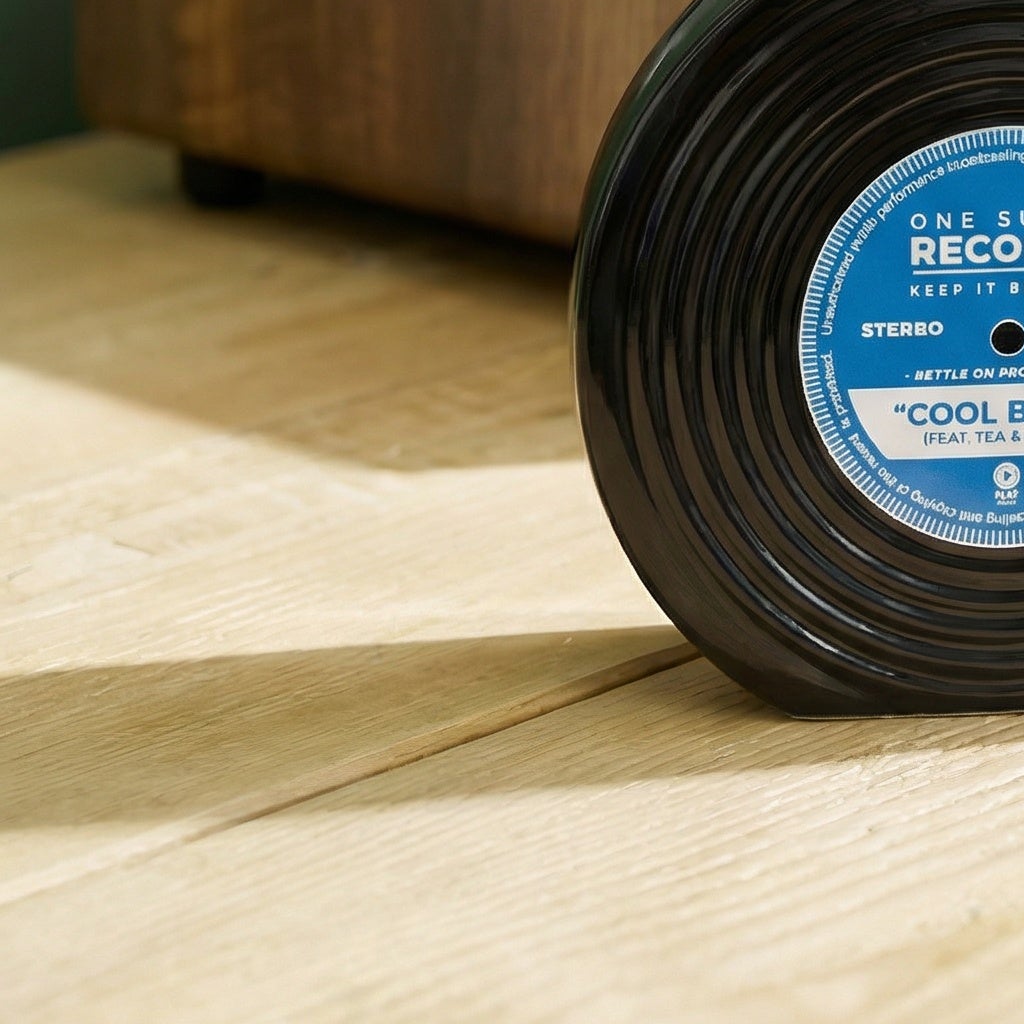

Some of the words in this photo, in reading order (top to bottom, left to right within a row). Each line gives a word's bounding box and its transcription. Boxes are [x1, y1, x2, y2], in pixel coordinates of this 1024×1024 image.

[910, 211, 975, 230] ONE
[910, 283, 963, 297] KEEP
[977, 282, 996, 295] IT
[972, 367, 995, 379] ON
[893, 400, 998, 427] “COOL
[974, 430, 1007, 443] TEA
[1010, 429, 1021, 443] &
